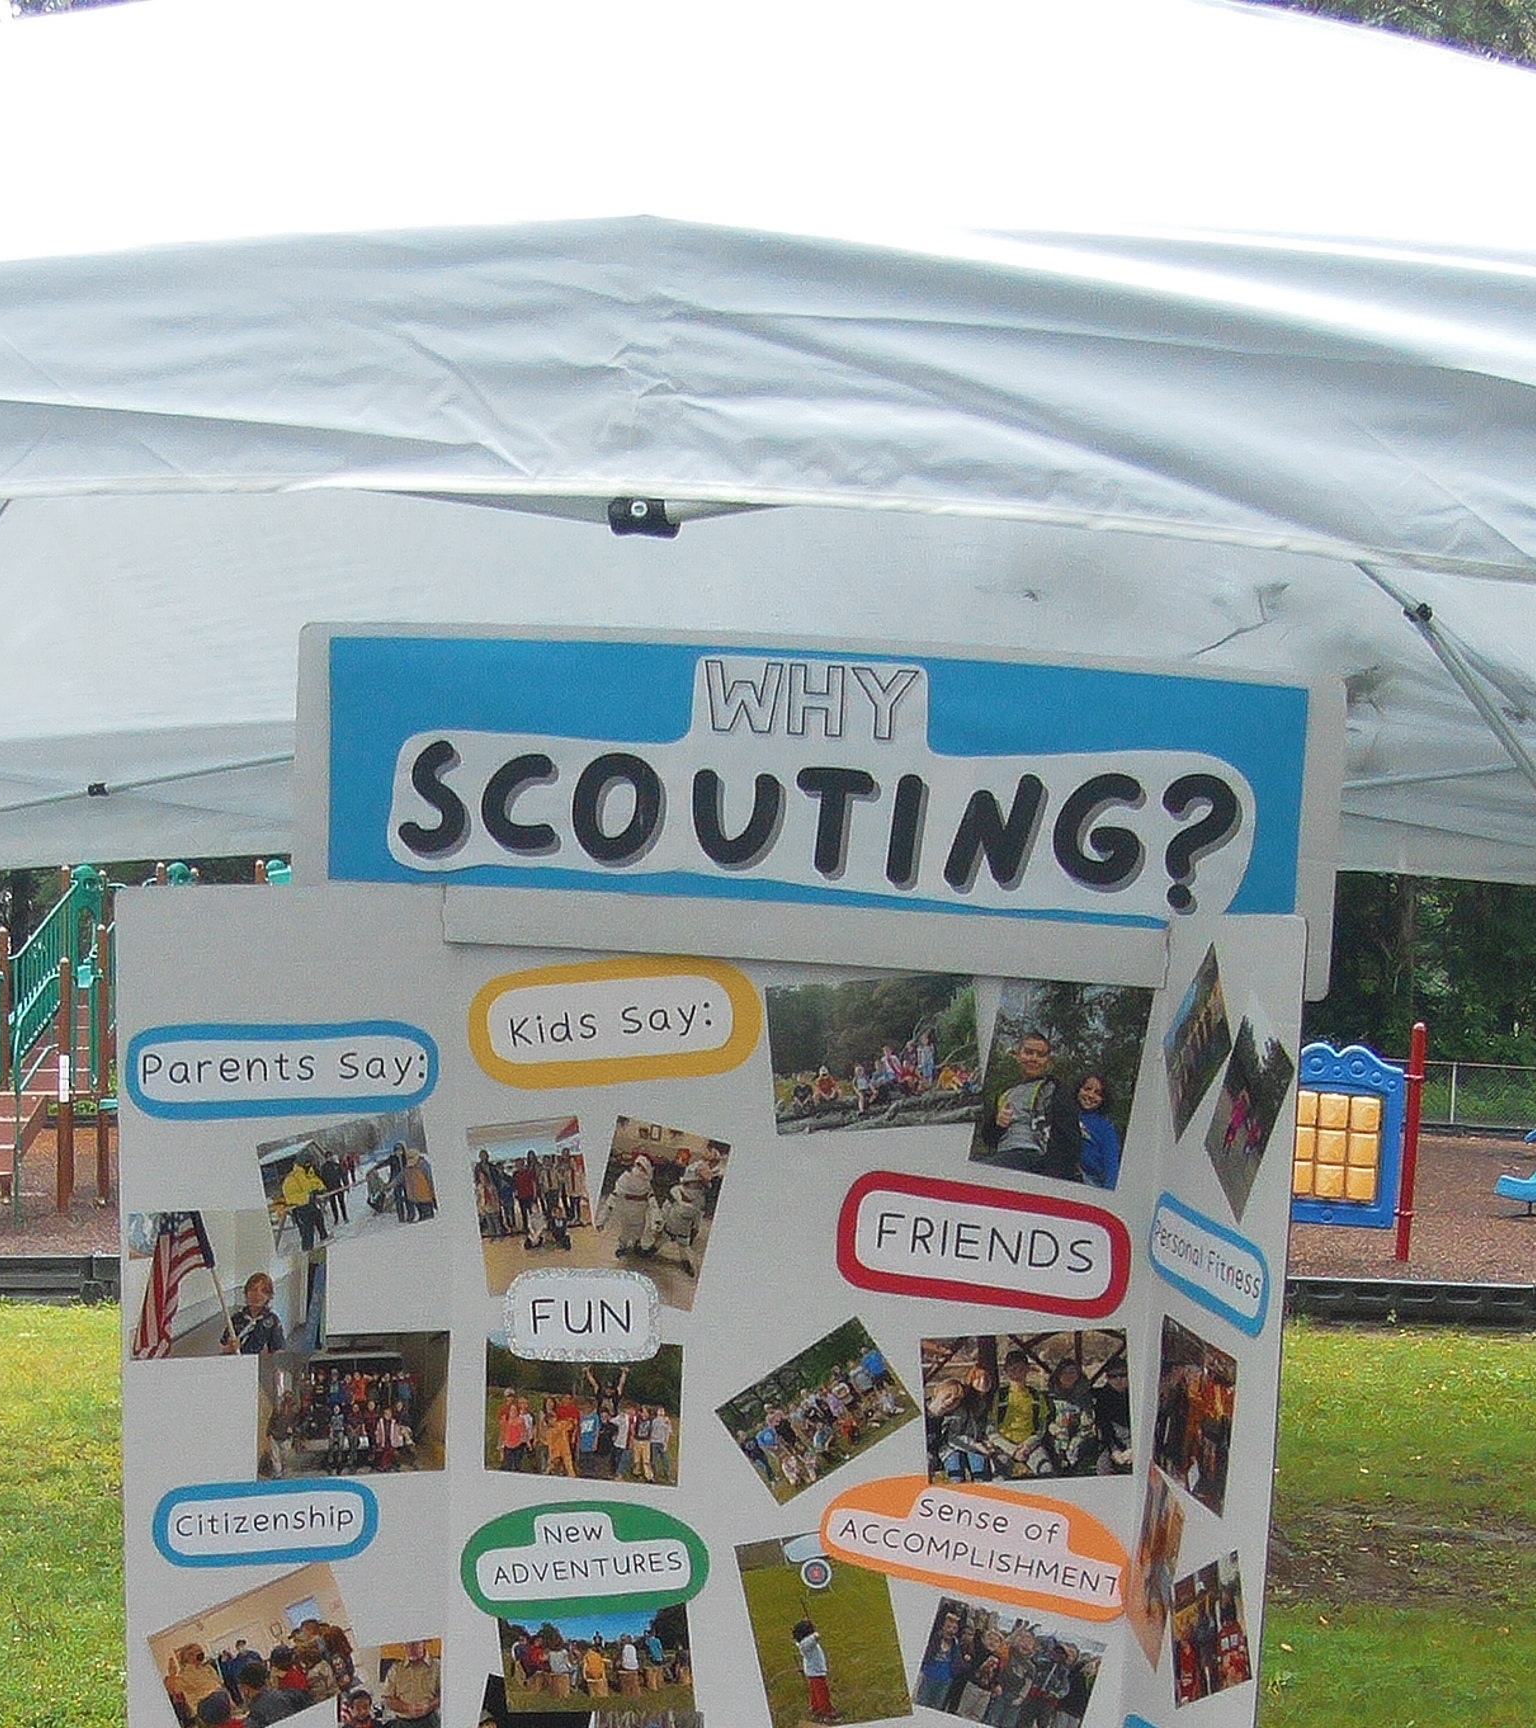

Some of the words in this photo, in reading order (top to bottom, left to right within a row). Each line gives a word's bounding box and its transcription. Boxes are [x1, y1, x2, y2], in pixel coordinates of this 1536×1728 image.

[702, 657, 922, 741] WHY
[395, 739, 1244, 915] SCOUTING?
[507, 1010, 599, 1049] Kids
[620, 999, 714, 1036] Say:
[141, 1050, 316, 1085] Parents
[338, 1050, 428, 1089] Say:
[875, 1210, 1095, 1275] FRIENDS
[1207, 1249, 1262, 1300] Fitness
[529, 1296, 633, 1337] FUN
[175, 1502, 355, 1540] Citizenship
[544, 1520, 604, 1546] New
[1023, 1520, 1061, 1546] of
[493, 1550, 683, 1587] ADVENTURES
[838, 1516, 1119, 1598] ACCOMPLISHMENT
